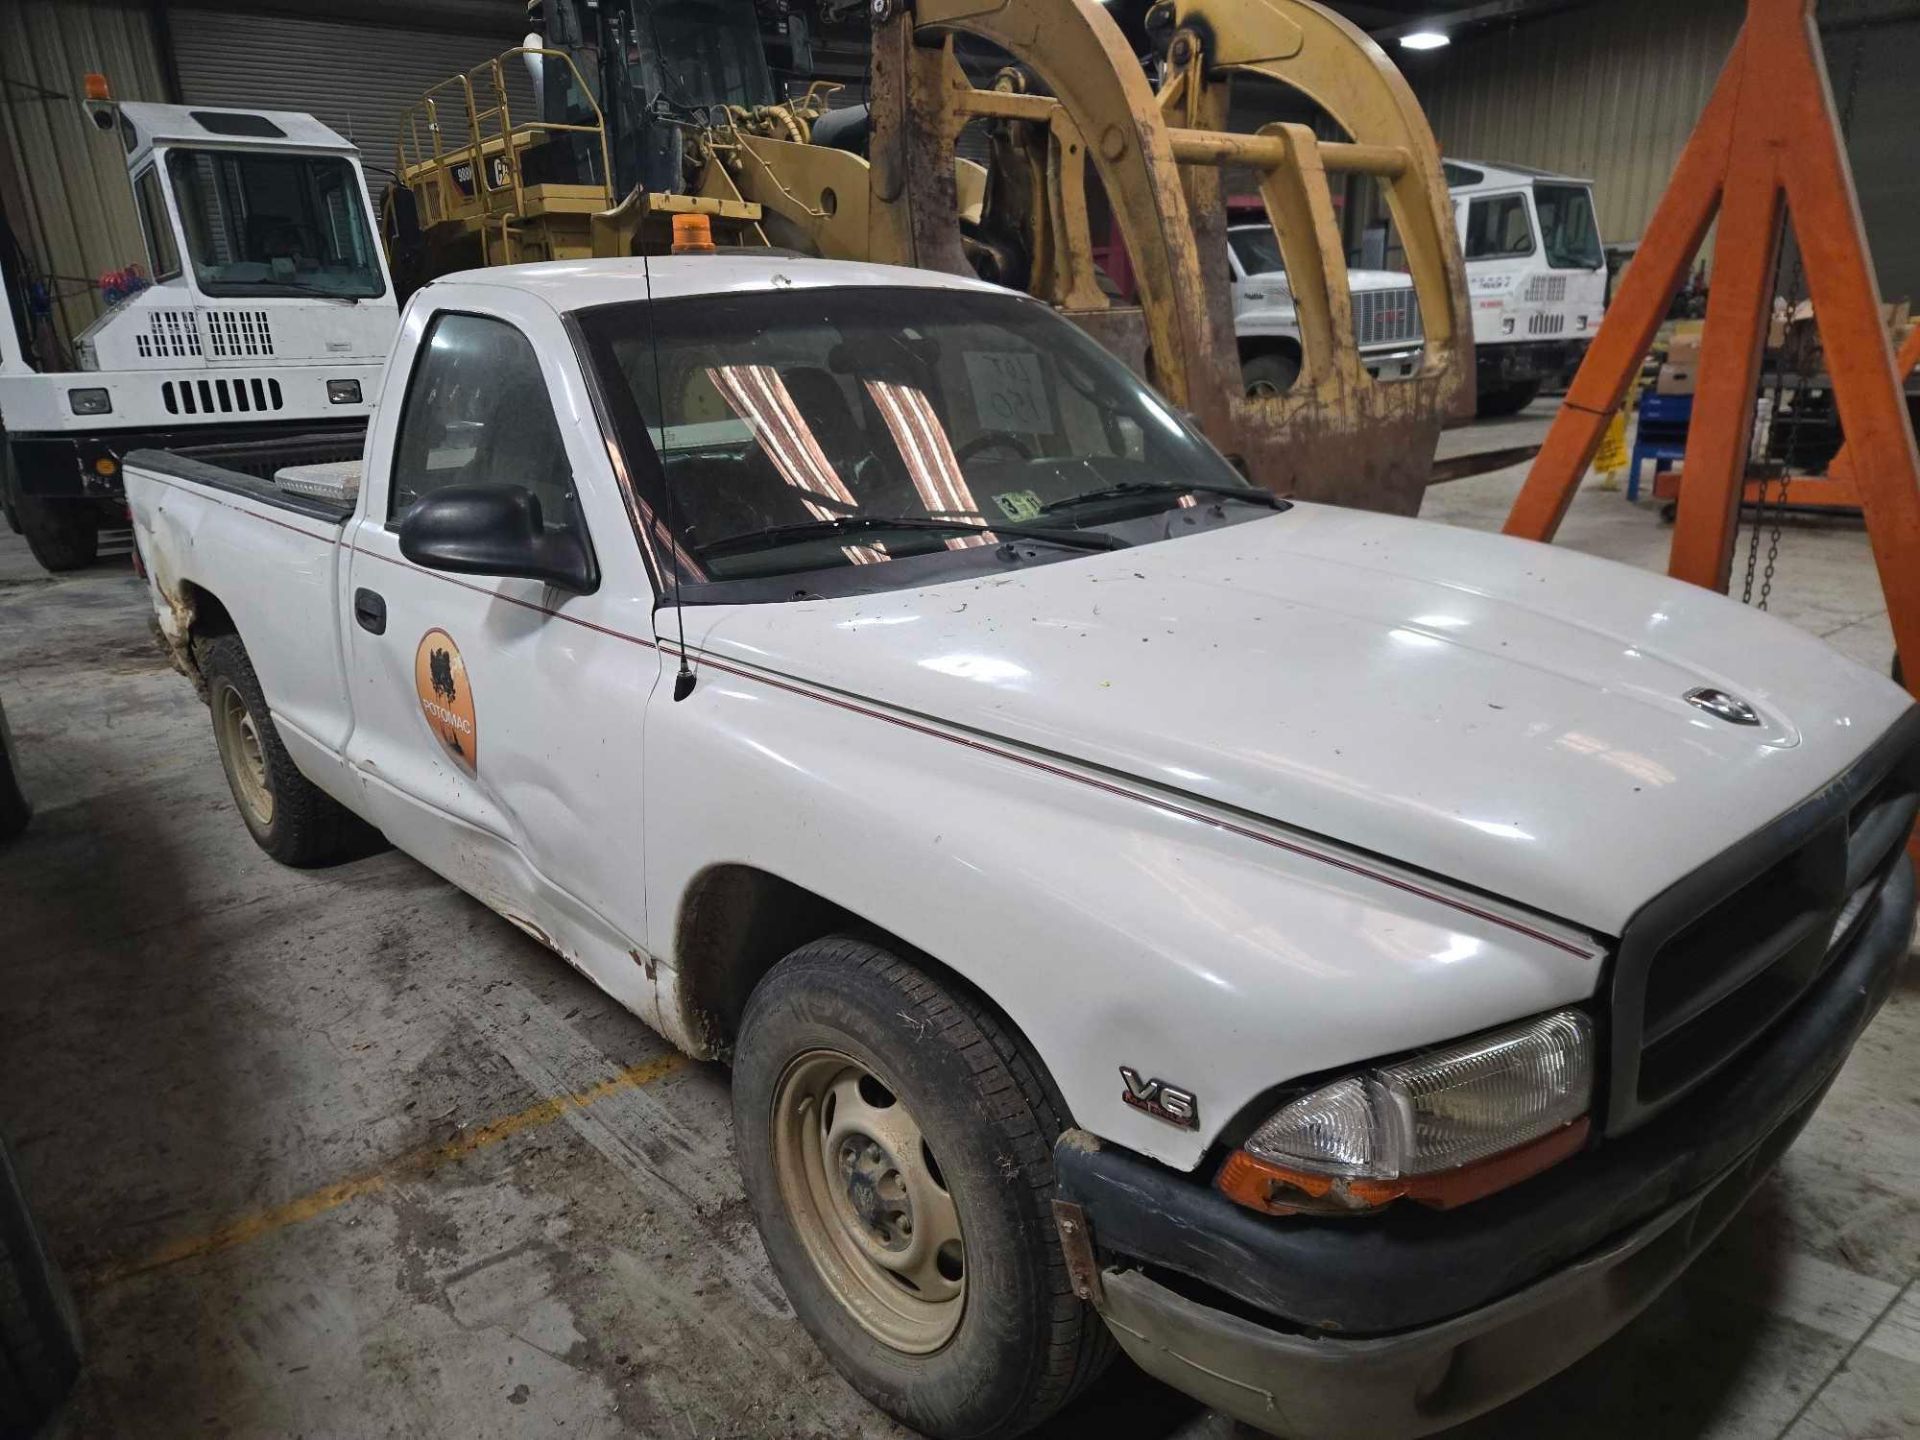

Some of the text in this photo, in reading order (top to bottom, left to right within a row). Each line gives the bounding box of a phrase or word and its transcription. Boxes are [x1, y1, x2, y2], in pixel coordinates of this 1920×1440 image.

[1001, 497, 1018, 514] 3
[422, 699, 471, 735] POTOMAC
[1119, 1066, 1197, 1119] V6
